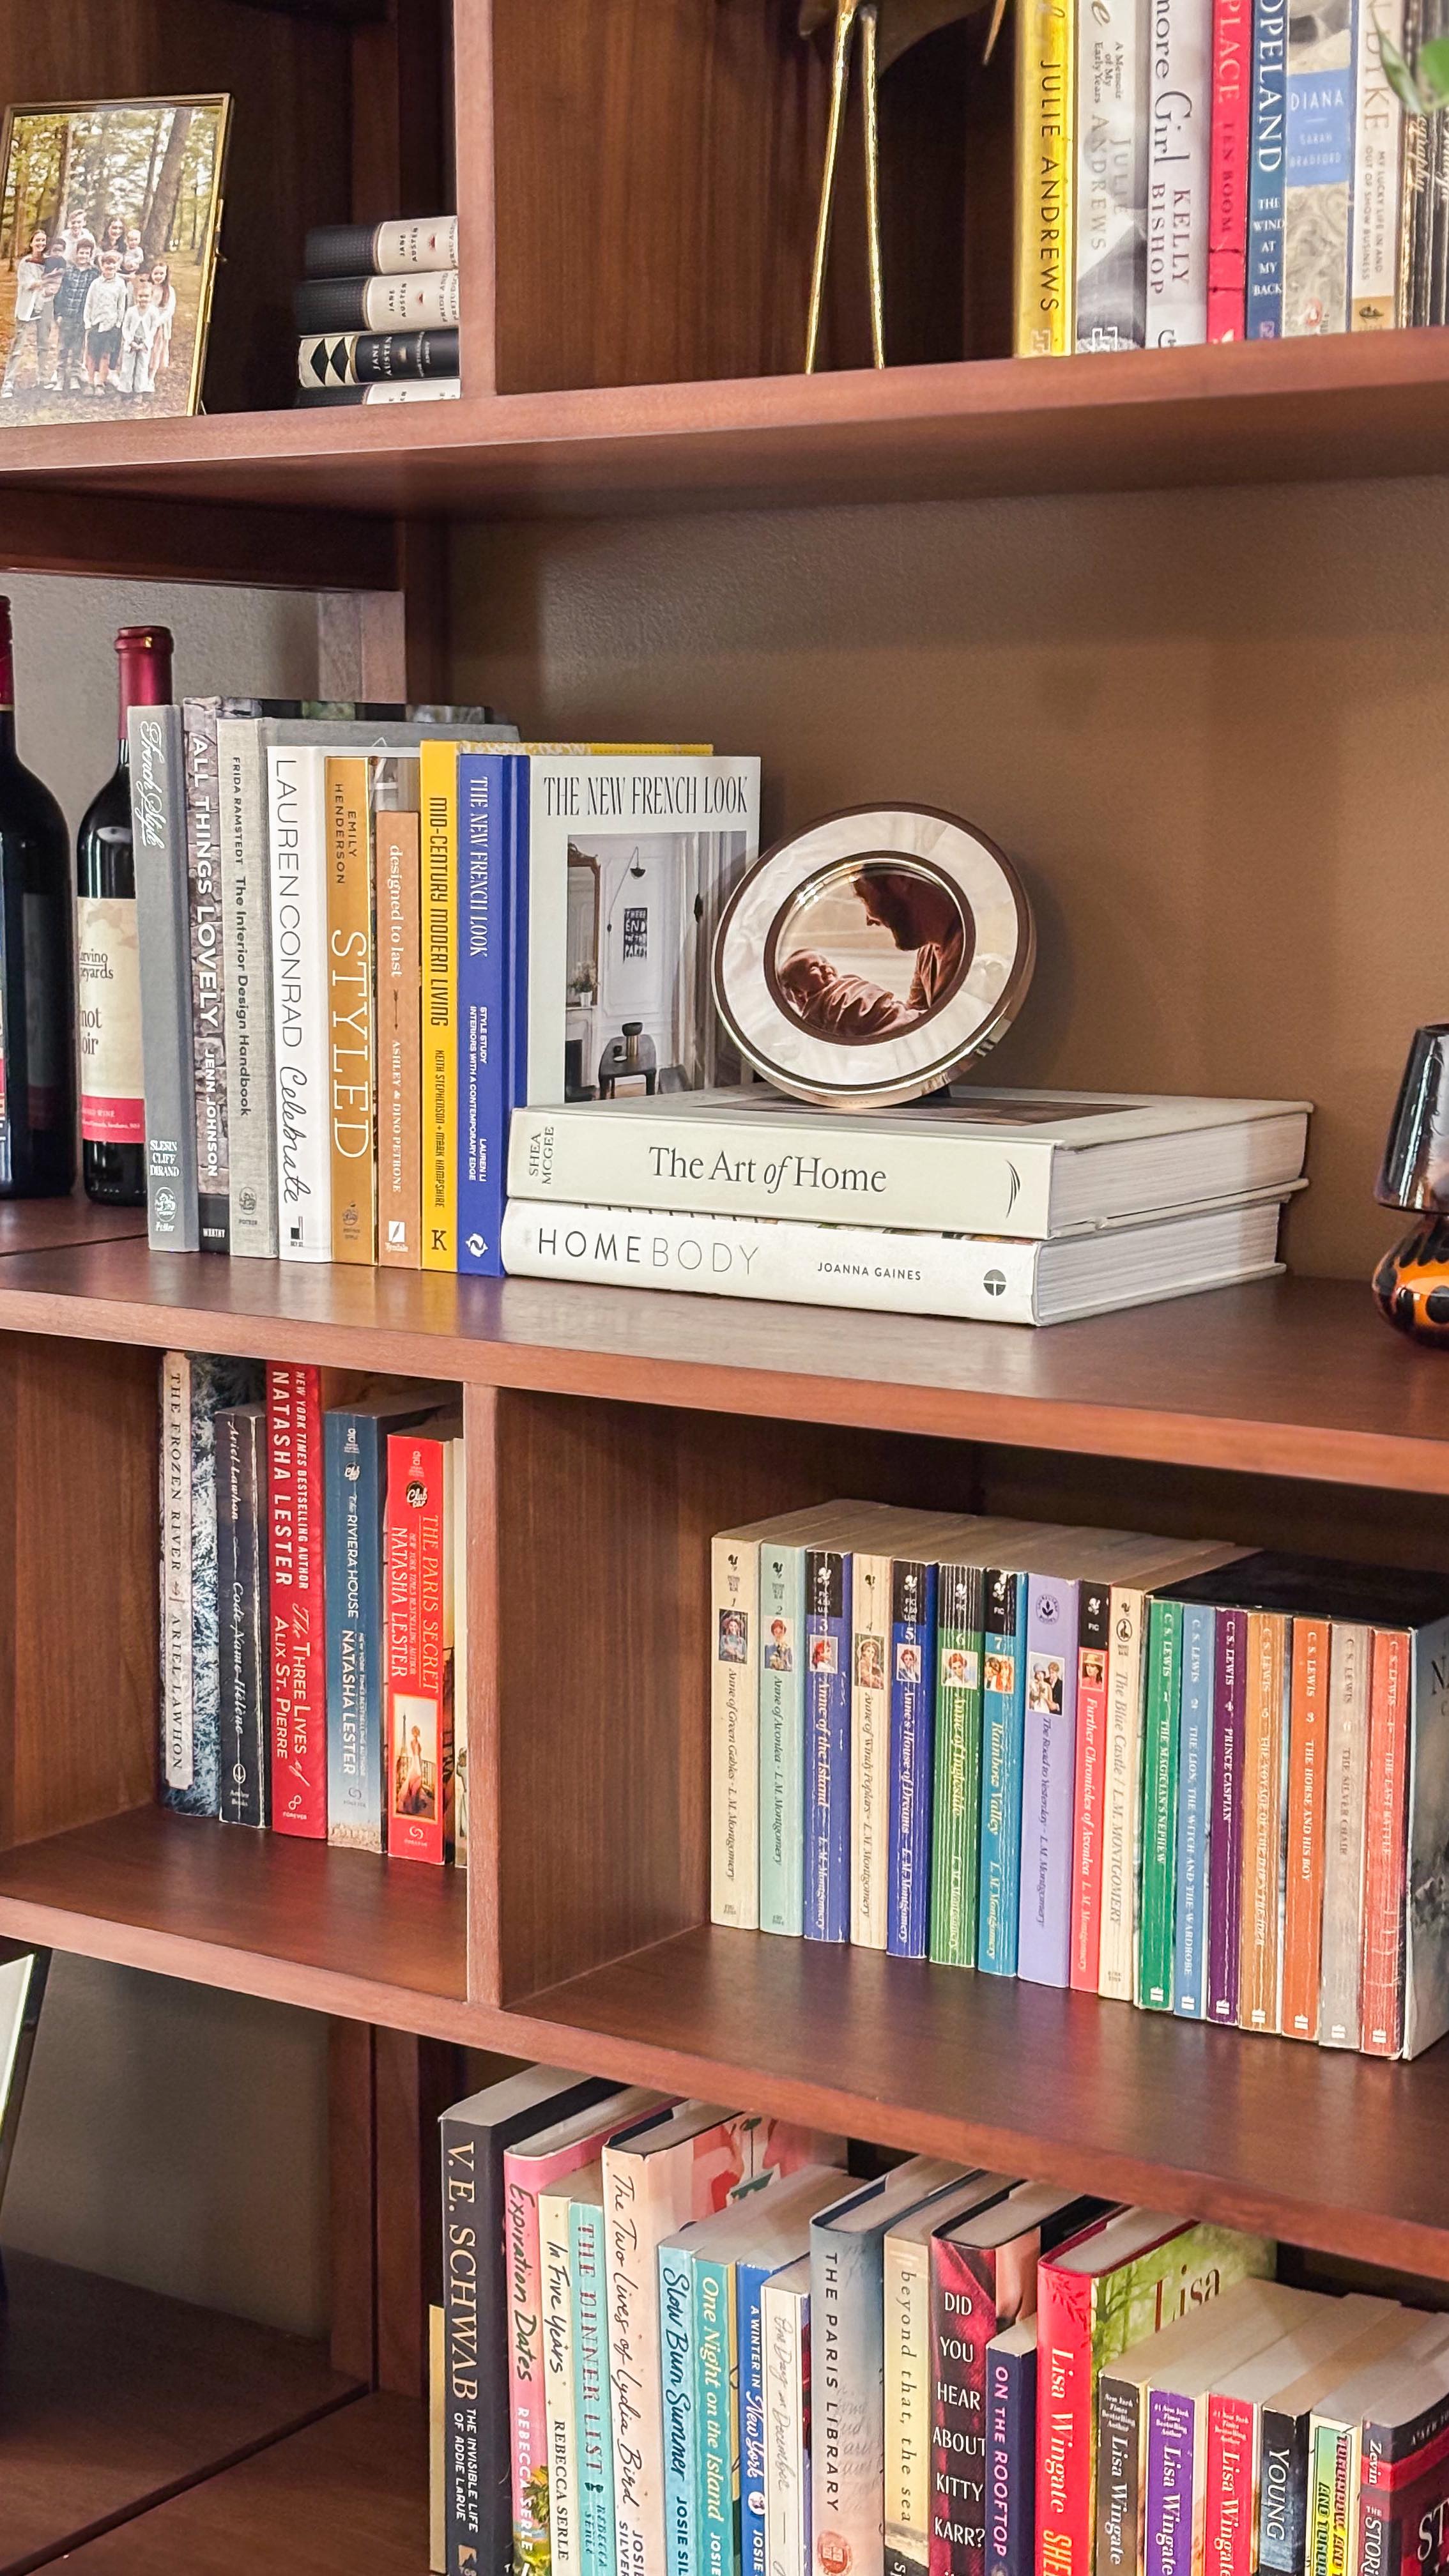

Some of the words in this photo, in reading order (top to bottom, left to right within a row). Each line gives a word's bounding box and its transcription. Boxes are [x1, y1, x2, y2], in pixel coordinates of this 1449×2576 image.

[1093, 42, 1103, 70] Early
[1041, 60, 1061, 137] JULIE
[1094, 72, 1103, 103] Years
[1291, 89, 1344, 111] DIANA
[1154, 91, 1192, 164] Girl
[1091, 115, 1109, 250] ANDREWS
[1110, 139, 1131, 214] JULIE
[1258, 198, 1281, 210] THE
[1039, 157, 1059, 311] ANDREWS
[1151, 183, 1165, 294] BISHOP
[1172, 190, 1191, 284] KELLY
[1261, 240, 1276, 252] AT
[1362, 229, 1371, 280] BUSINESS
[1259, 262, 1277, 273] MY
[1375, 246, 1384, 273] AND
[1254, 284, 1282, 296] BACK
[193, 739, 208, 788] ALL
[233, 757, 241, 794] FRIDA
[470, 776, 488, 808] THE
[543, 776, 580, 816] THE
[588, 776, 625, 815] NEW
[632, 776, 696, 814] FRENCH
[703, 776, 747, 813] LOOK
[195, 796, 213, 894] THINGS
[234, 798, 245, 865] RAMSTEDT
[276, 760, 300, 896] LAUREN
[335, 783, 345, 884] HENDERSON
[348, 811, 357, 857] EMILY
[429, 797, 448, 902] MID-CENTURY
[470, 813, 488, 848] NEW
[235, 877, 246, 906] The
[387, 845, 403, 921] designed
[470, 852, 488, 910] FRENCH
[236, 912, 247, 971] Interior
[390, 926, 402, 943] to
[430, 908, 448, 973] MODERN
[470, 917, 488, 958] LOOK
[197, 906, 218, 1027] LOVELY
[279, 905, 302, 1047] CONRAD
[390, 946, 404, 977] last
[236, 976, 249, 1029] Design
[431, 979, 448, 1027] LIVING
[332, 929, 369, 1158] STYLED
[392, 1041, 402, 1086] ASHLEY
[204, 1048, 216, 1093] JENN
[239, 1035, 252, 1116] Handbook
[434, 1075, 445, 1124] STEPHENSON
[469, 1084, 477, 1156] CONTEMPORARY
[152, 1153, 176, 1165] CLIFF
[206, 1096, 218, 1176] JOHNSON
[280, 1066, 311, 1204] Celebrate
[529, 1132, 540, 1176] SHEA
[542, 1126, 554, 1184] MCGEE
[150, 1165, 180, 1176] DIRAND
[392, 1132, 401, 1193] PETRONE
[434, 1160, 445, 1208] HAMPSHIRE
[648, 1146, 703, 1179] The
[708, 1151, 756, 1183] Art
[763, 1156, 792, 1194] of
[794, 1156, 887, 1193] Home
[539, 1228, 759, 1275] HOMEBODY
[818, 1262, 869, 1276] JOANNA
[874, 1267, 921, 1281] GAINES
[171, 1374, 180, 1413] THE
[296, 1371, 305, 1397] NEW
[272, 1371, 291, 1480] NATASHA
[296, 1401, 307, 1429] YORK
[171, 1423, 181, 1499] FROZEN
[296, 1433, 307, 1467] TIMES
[297, 1471, 308, 1542] BESTSELLING
[171, 1512, 181, 1570] RIVER
[274, 1494, 293, 1586] LESTER
[346, 1514, 358, 1568] RIVIERA
[422, 1515, 438, 1549] THE
[298, 1546, 309, 1590] AUTHOR
[422, 1558, 438, 1613] PARIS
[347, 1568, 359, 1619] HOUSE
[994, 1607, 1004, 1615] FIC
[170, 1615, 181, 1675] ARIEL
[275, 1615, 289, 1658] ALIX
[1088, 1623, 1100, 1632] FIC
[275, 1662, 291, 1691] ST.
[293, 1641, 310, 1701] THREE
[341, 1630, 355, 1710] NATASHA
[422, 1621, 439, 1694] SECRET
[1116, 1671, 1128, 1692] The
[1163, 1641, 1173, 1677] LEWIS
[1225, 1649, 1234, 1686] LEWIS
[1306, 1660, 1316, 1698] LEWIS
[171, 1684, 183, 1769] LAWHON
[275, 1698, 291, 1759] PIERRE
[293, 1704, 311, 1754] LIVES
[1084, 1698, 1098, 1740] Further
[1116, 1698, 1127, 1729] Blue
[342, 1712, 355, 1774] LESTER
[1114, 1733, 1127, 1776] Castle
[1223, 1728, 1234, 1769] PRINCE
[1083, 1744, 1096, 1813] Chronicles
[1223, 1772, 1234, 1822] CASPIAN
[1304, 1766, 1314, 1809] HORSE
[988, 1790, 1002, 1835] Valley
[1082, 1828, 1093, 1874] Avonlea
[1301, 1857, 1312, 1881] BOY
[1110, 1823, 1123, 1928] MONTGOMERY
[448, 2142, 474, 2172] V.
[448, 2177, 475, 2211] E.
[507, 2183, 536, 2303] Expiration
[702, 2276, 719, 2323] One
[825, 2253, 838, 2300] THE
[448, 2224, 478, 2400] SCHWAB
[896, 2271, 917, 2358] beyond
[944, 2292, 972, 2316] DID
[514, 2309, 537, 2382] Dates
[701, 2328, 721, 2387] Night
[825, 2314, 838, 2389] PARIS
[940, 2336, 974, 2363] YOU
[937, 2381, 981, 2411] HEAR
[994, 2366, 1008, 2400] ON
[1051, 2347, 1074, 2400] Lisa
[466, 2407, 477, 2435] THE
[900, 2372, 917, 2425] that,
[517, 2407, 531, 2491] REBECCA
[933, 2426, 985, 2457] ABOUT
[994, 2406, 1006, 2444] THE
[467, 2439, 478, 2497] INVISIBLE
[554, 2421, 567, 2502] REBECCA
[825, 2402, 839, 2511] LIBRARY
[900, 2437, 917, 2476] the
[1044, 2412, 1074, 2515] Wingate
[1368, 2439, 1382, 2485] Zevin
[706, 2453, 724, 2522] Island
[901, 2486, 911, 2522] sea
[936, 2473, 983, 2503] KITTY
[993, 2450, 1008, 2557] ROOFTOP
[1266, 2449, 1290, 2541] YOUNG
[468, 2500, 478, 2533] LIFE
[557, 2506, 569, 2561] SERLE
[934, 2517, 985, 2548] KARR?
